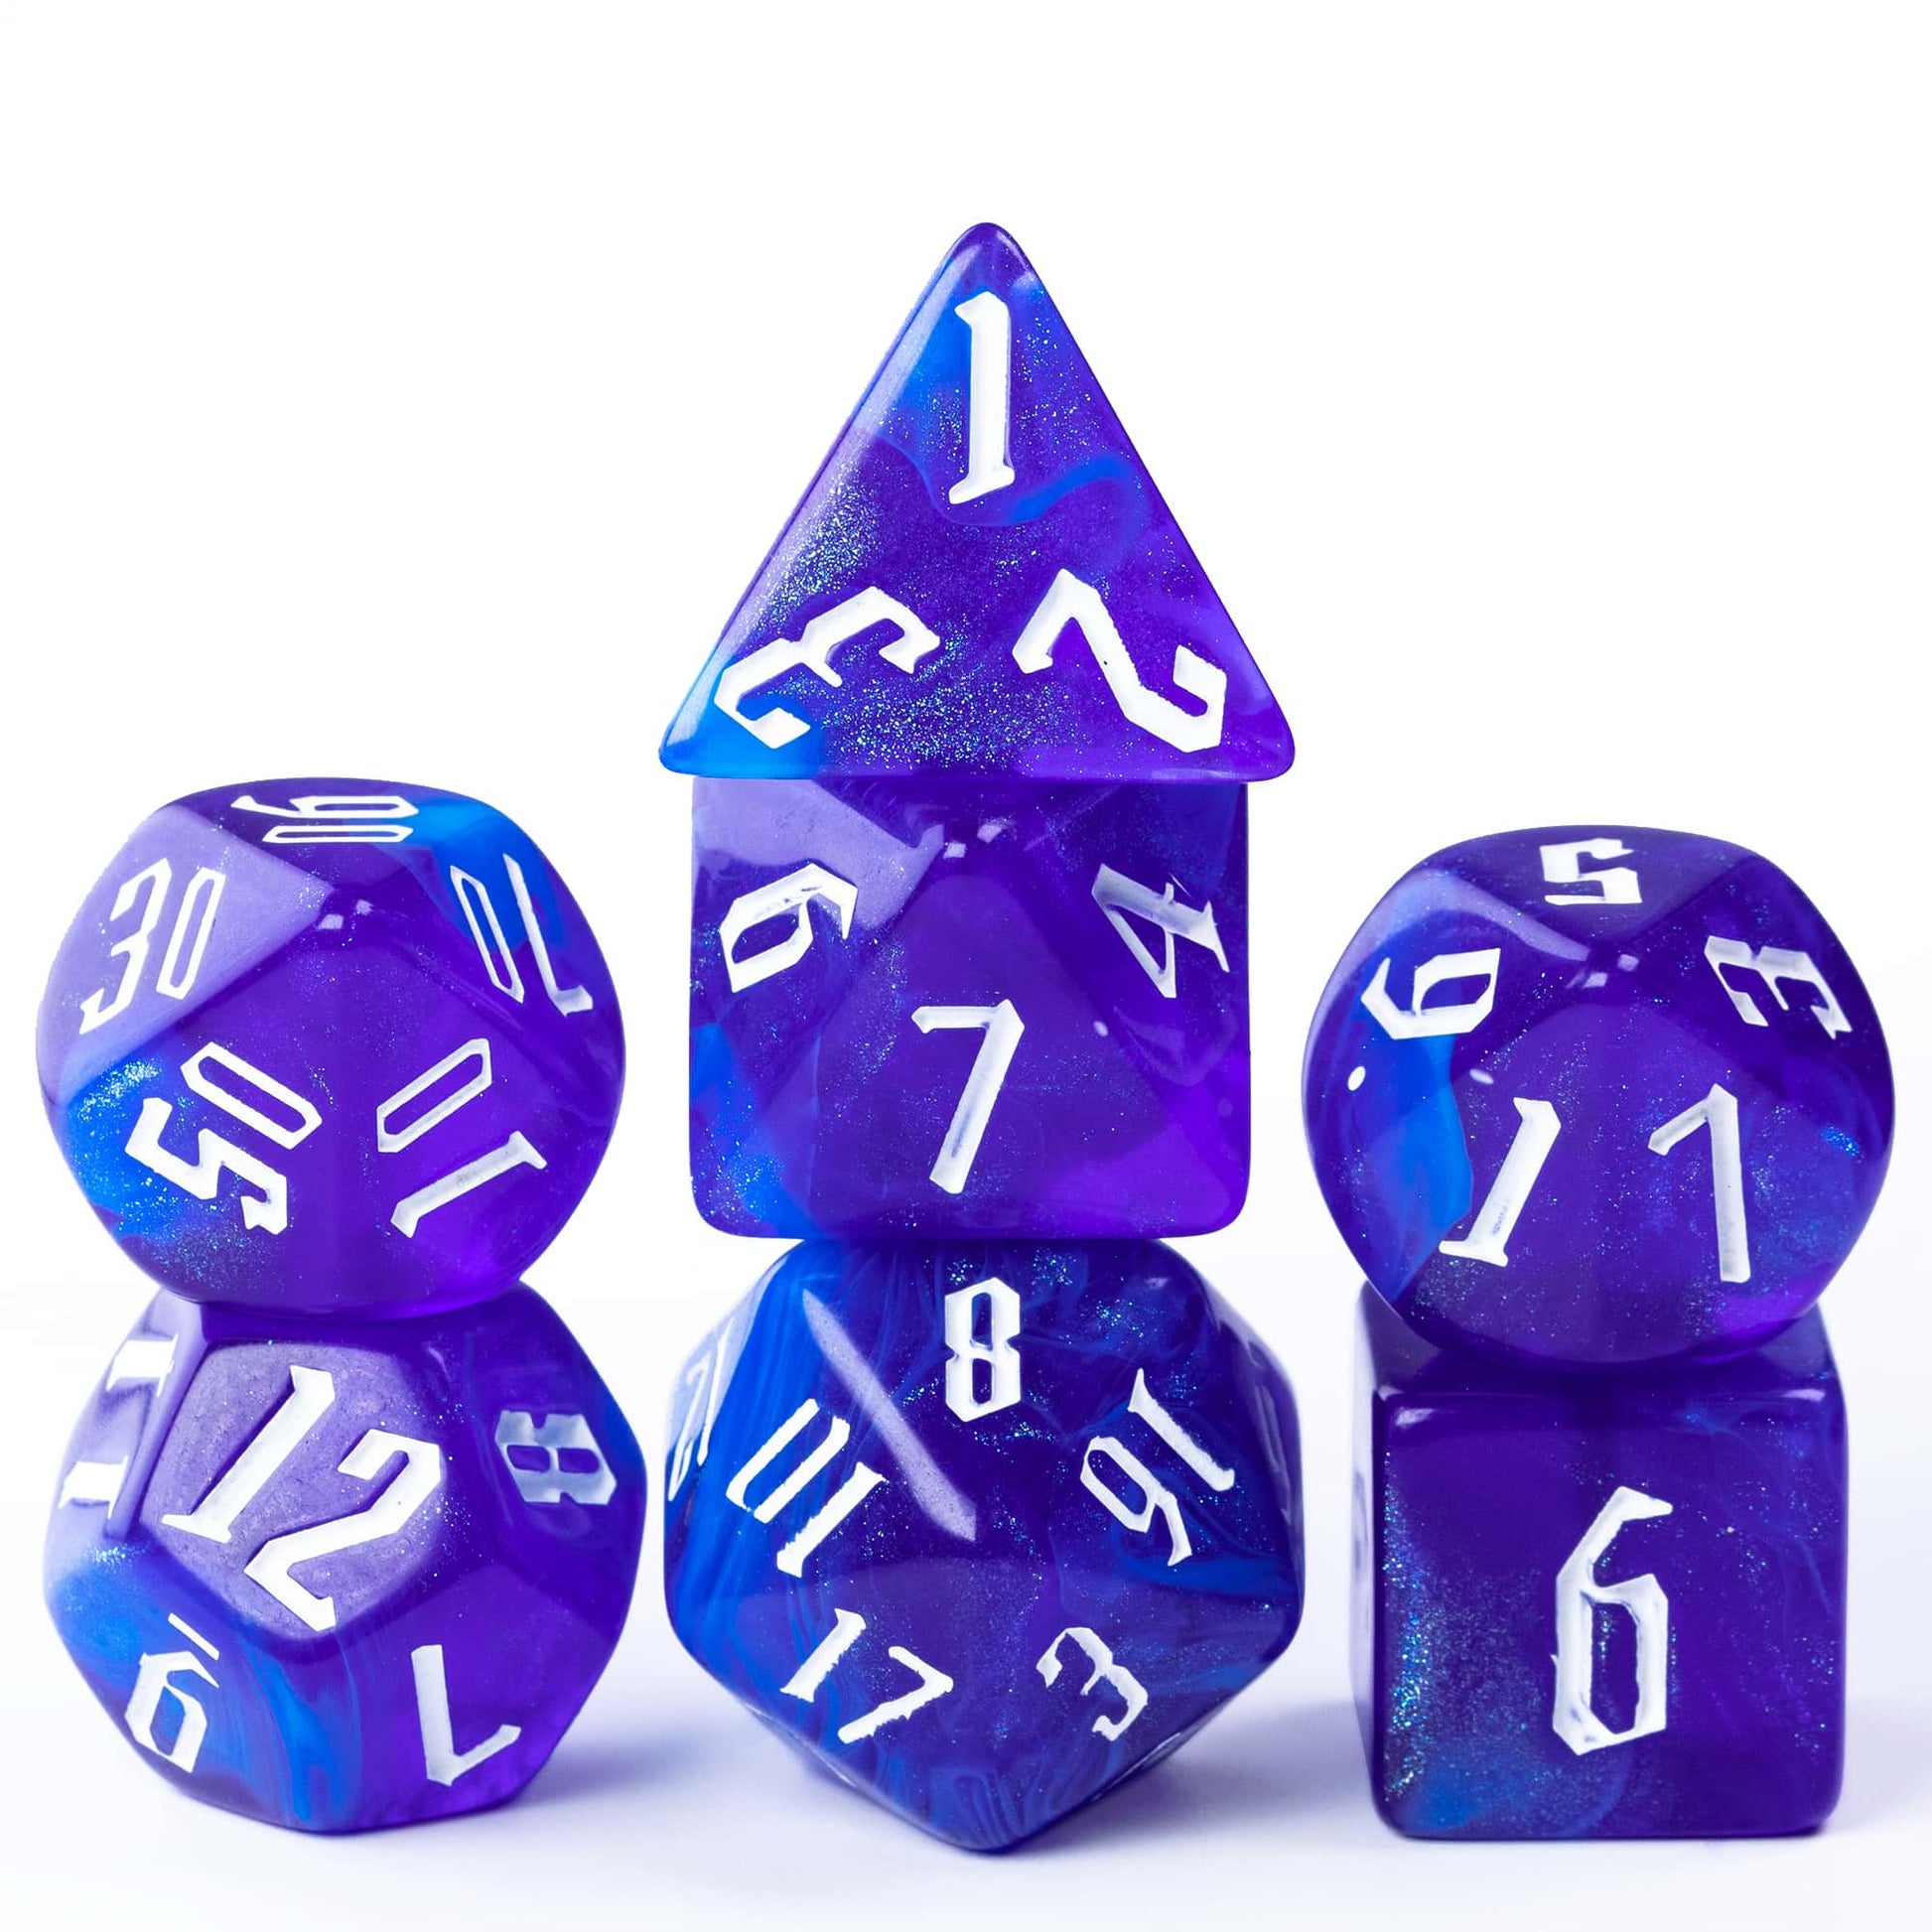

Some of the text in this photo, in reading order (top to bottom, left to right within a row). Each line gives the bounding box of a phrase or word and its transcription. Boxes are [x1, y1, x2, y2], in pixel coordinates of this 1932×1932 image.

[948, 291, 1015, 504] 1
[714, 585, 940, 749] 3
[1012, 568, 1227, 753] 2
[79, 858, 226, 1035] 30
[451, 853, 594, 1017] 70
[1092, 864, 1229, 999] 4
[1705, 935, 1853, 1039] 3
[125, 1041, 323, 1235] 50
[376, 1037, 547, 1238] 10
[911, 999, 1025, 1194] 7
[1439, 1097, 1562, 1267] 1
[1648, 1084, 1750, 1283] 7
[945, 1278, 1021, 1422] 8
[162, 1365, 441, 1632] 12
[495, 1410, 618, 1505] 8
[1080, 1368, 1235, 1567] 16
[780, 1607, 953, 1743] 17
[1036, 1627, 1148, 1740] 3
[1551, 1486, 1673, 1755] 6
[410, 1644, 522, 1786] 7
